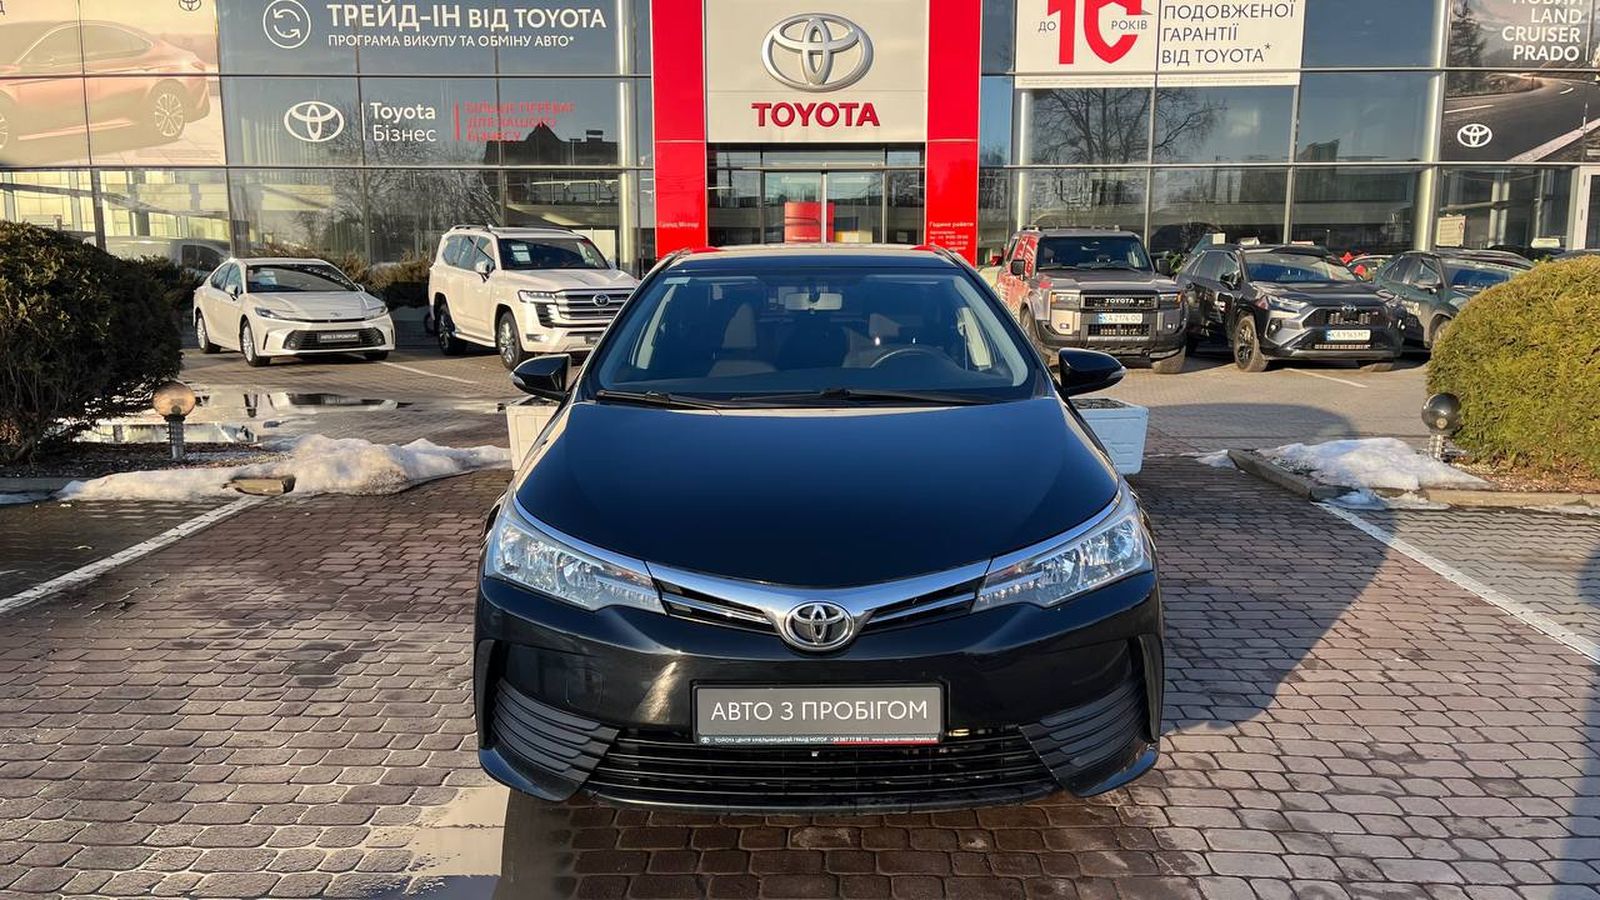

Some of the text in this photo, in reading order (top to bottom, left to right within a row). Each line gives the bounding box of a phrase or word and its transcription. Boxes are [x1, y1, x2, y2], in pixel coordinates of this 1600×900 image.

[326, 0, 607, 32] ТРЕЙД-ІН ВІД TOYOTA
[1163, 0, 1297, 21] ПОДОВЖЕНОЇ
[1531, 8, 1583, 25] LAND
[1037, 21, 1057, 33] ДО
[1110, 20, 1148, 31] РОКІВ
[1162, 23, 1240, 42] ГАРАНТІЇ
[328, 34, 401, 47] ПРОГРАМА
[403, 34, 457, 47] ВИКУПУ
[459, 35, 476, 47] ТА
[478, 35, 532, 47] ОБМІНУ
[1502, 26, 1581, 43] CRUISER
[1161, 50, 1190, 67] ВІД
[1512, 45, 1580, 61] PRADO
[369, 102, 436, 124] Toyota
[751, 102, 880, 128] TOYOTA
[373, 124, 437, 142] Бізнес
[711, 701, 773, 721] АВТО
[801, 700, 928, 720] ПРОБІГОМ
